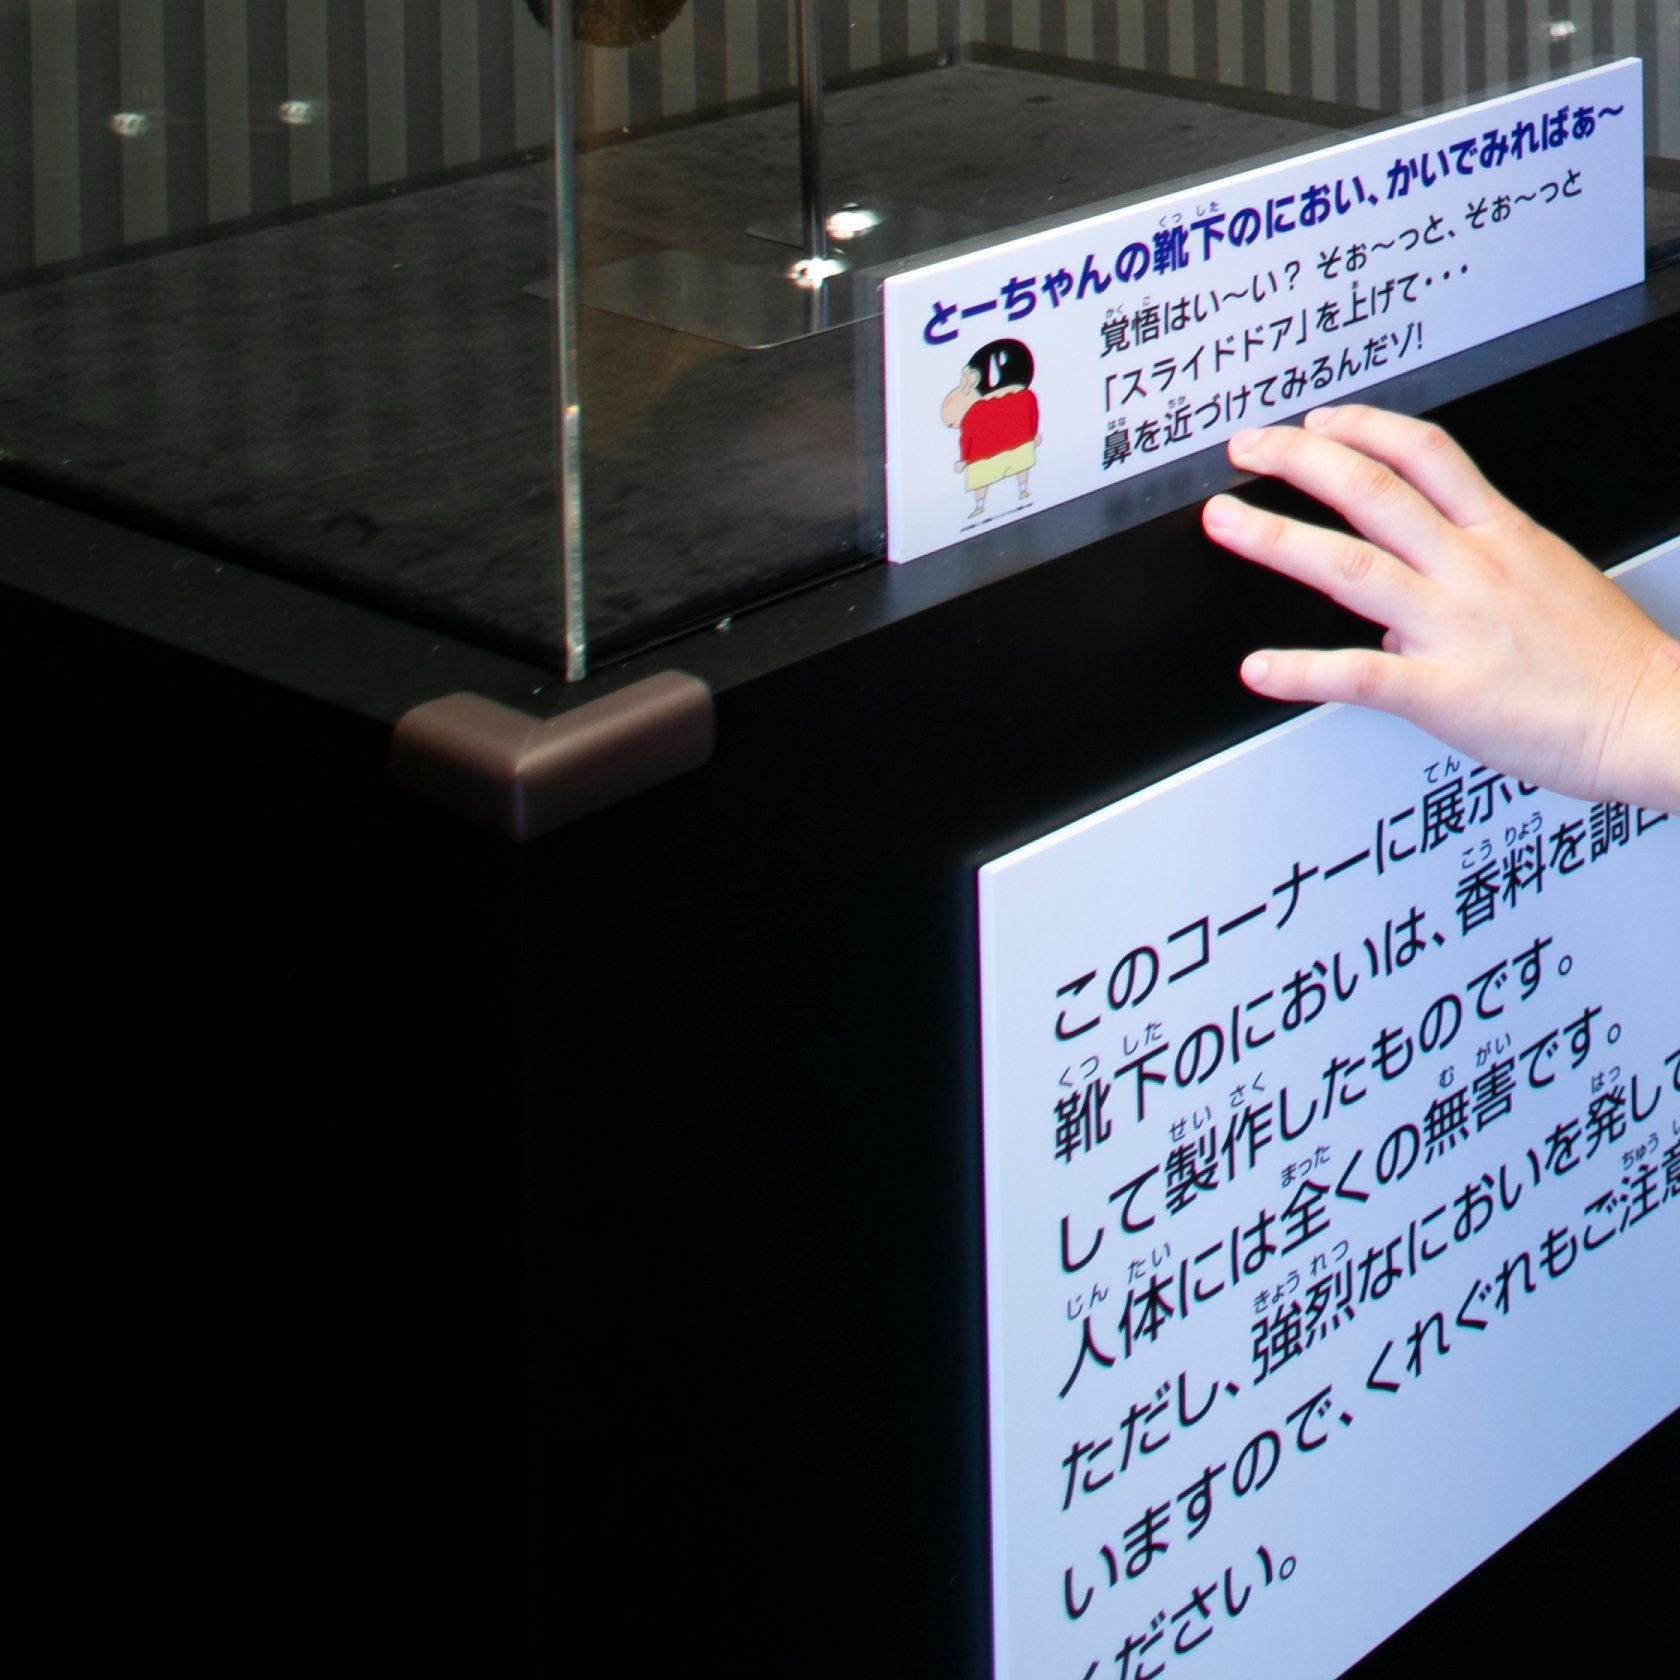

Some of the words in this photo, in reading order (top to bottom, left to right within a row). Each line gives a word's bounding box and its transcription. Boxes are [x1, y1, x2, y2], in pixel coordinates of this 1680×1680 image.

[1102, 321, 1422, 470] 鼻を近づけてみるんだゾ！
[1058, 1005, 1621, 1399] 人体には全くの無害です。
[1060, 936, 1573, 1274] して製作したものです。
